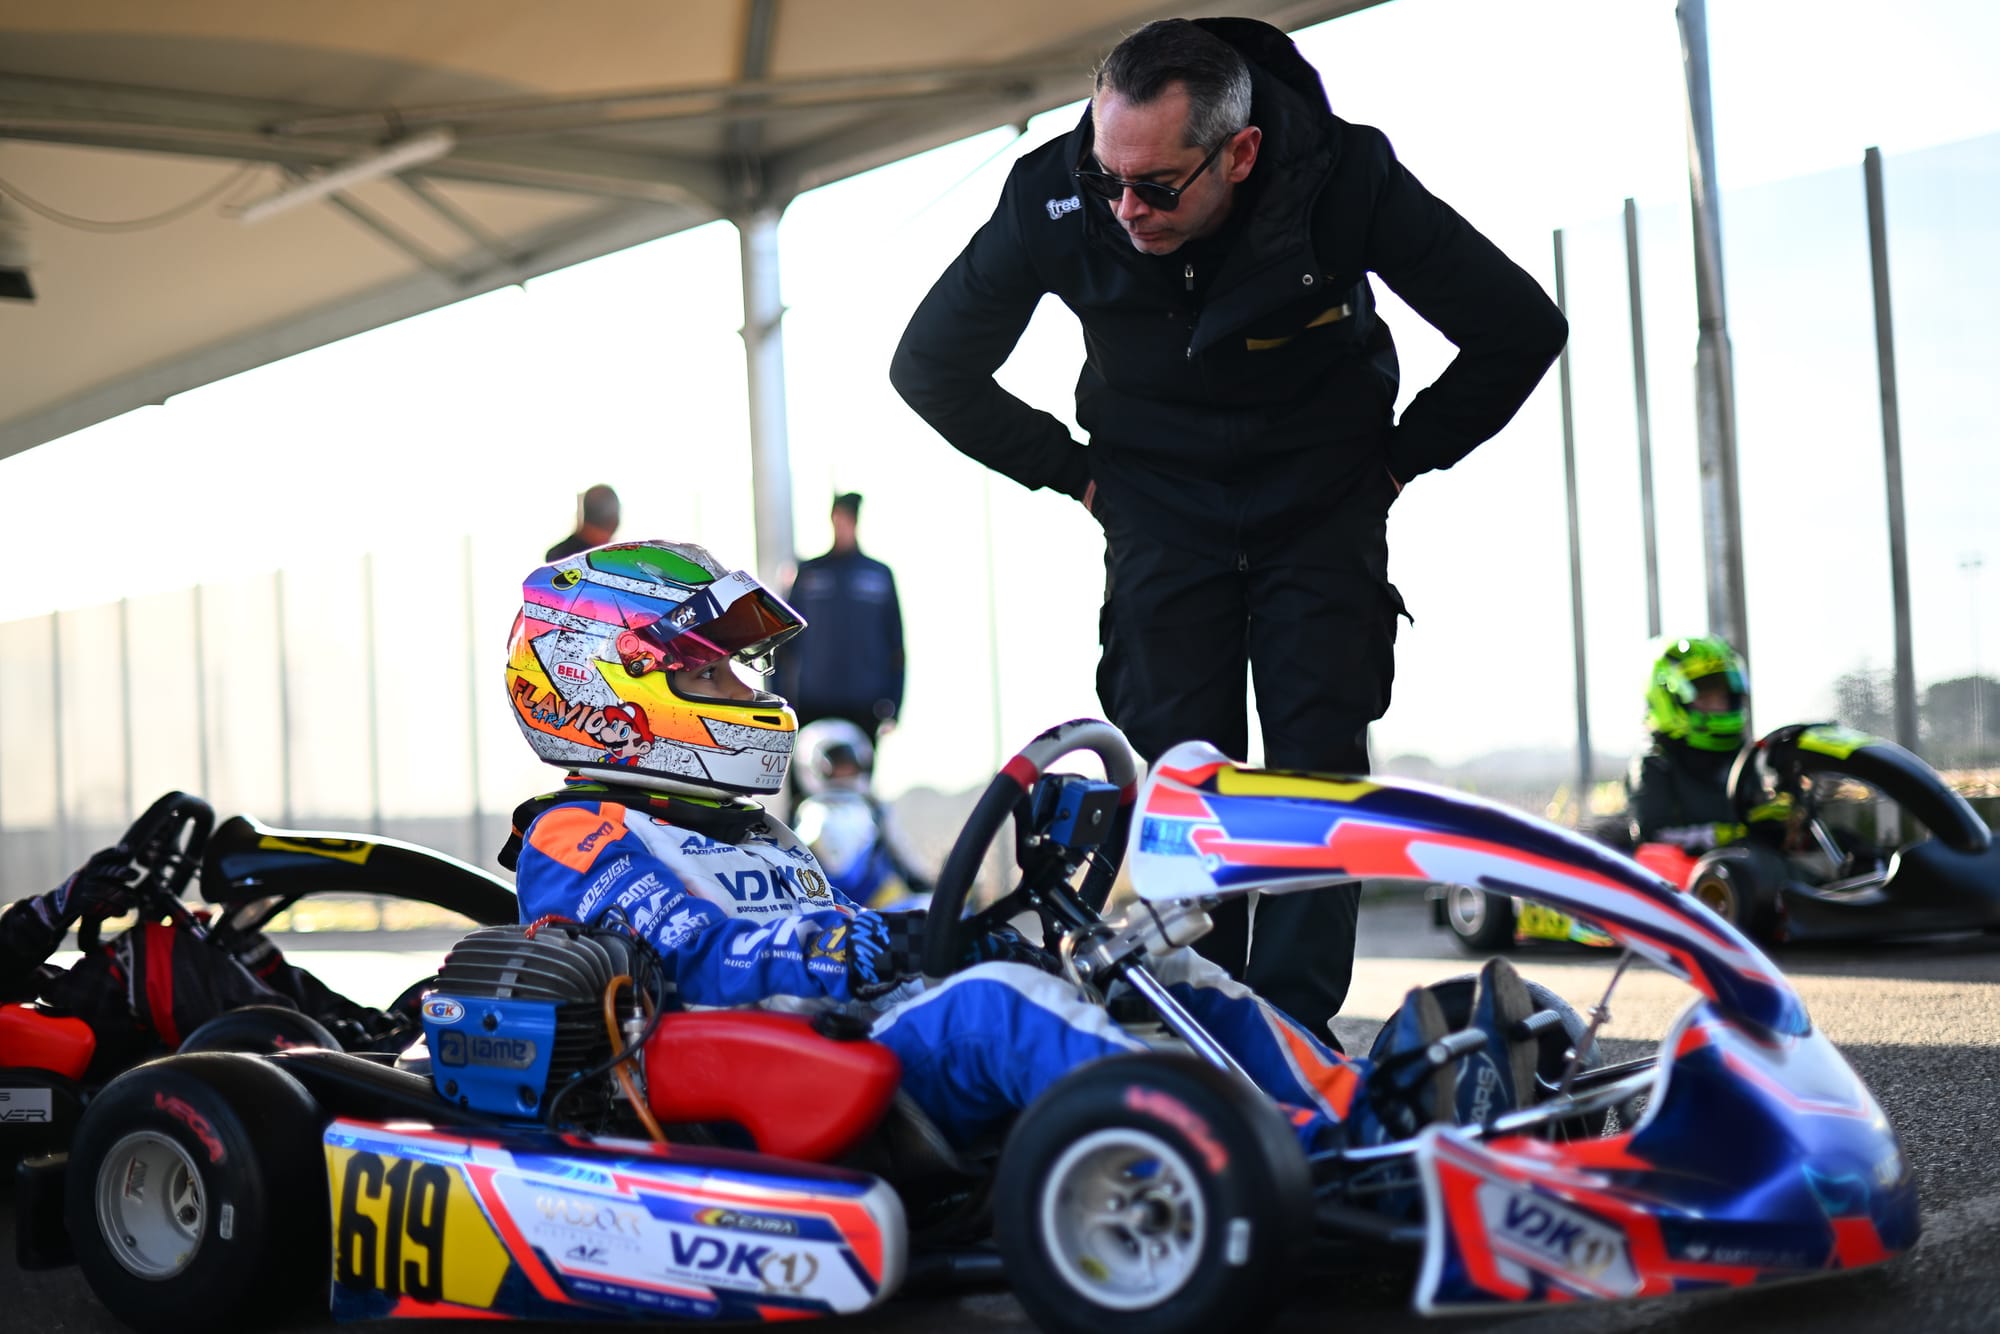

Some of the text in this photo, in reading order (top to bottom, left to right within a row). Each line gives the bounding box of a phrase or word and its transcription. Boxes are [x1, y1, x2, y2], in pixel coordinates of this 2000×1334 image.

[557, 664, 588, 681] BELL
[512, 675, 606, 735] FLAVIO
[715, 865, 804, 902] VDK
[337, 1150, 452, 1304] 619
[1505, 1195, 1584, 1254] VDK
[669, 1229, 773, 1280] VDK
